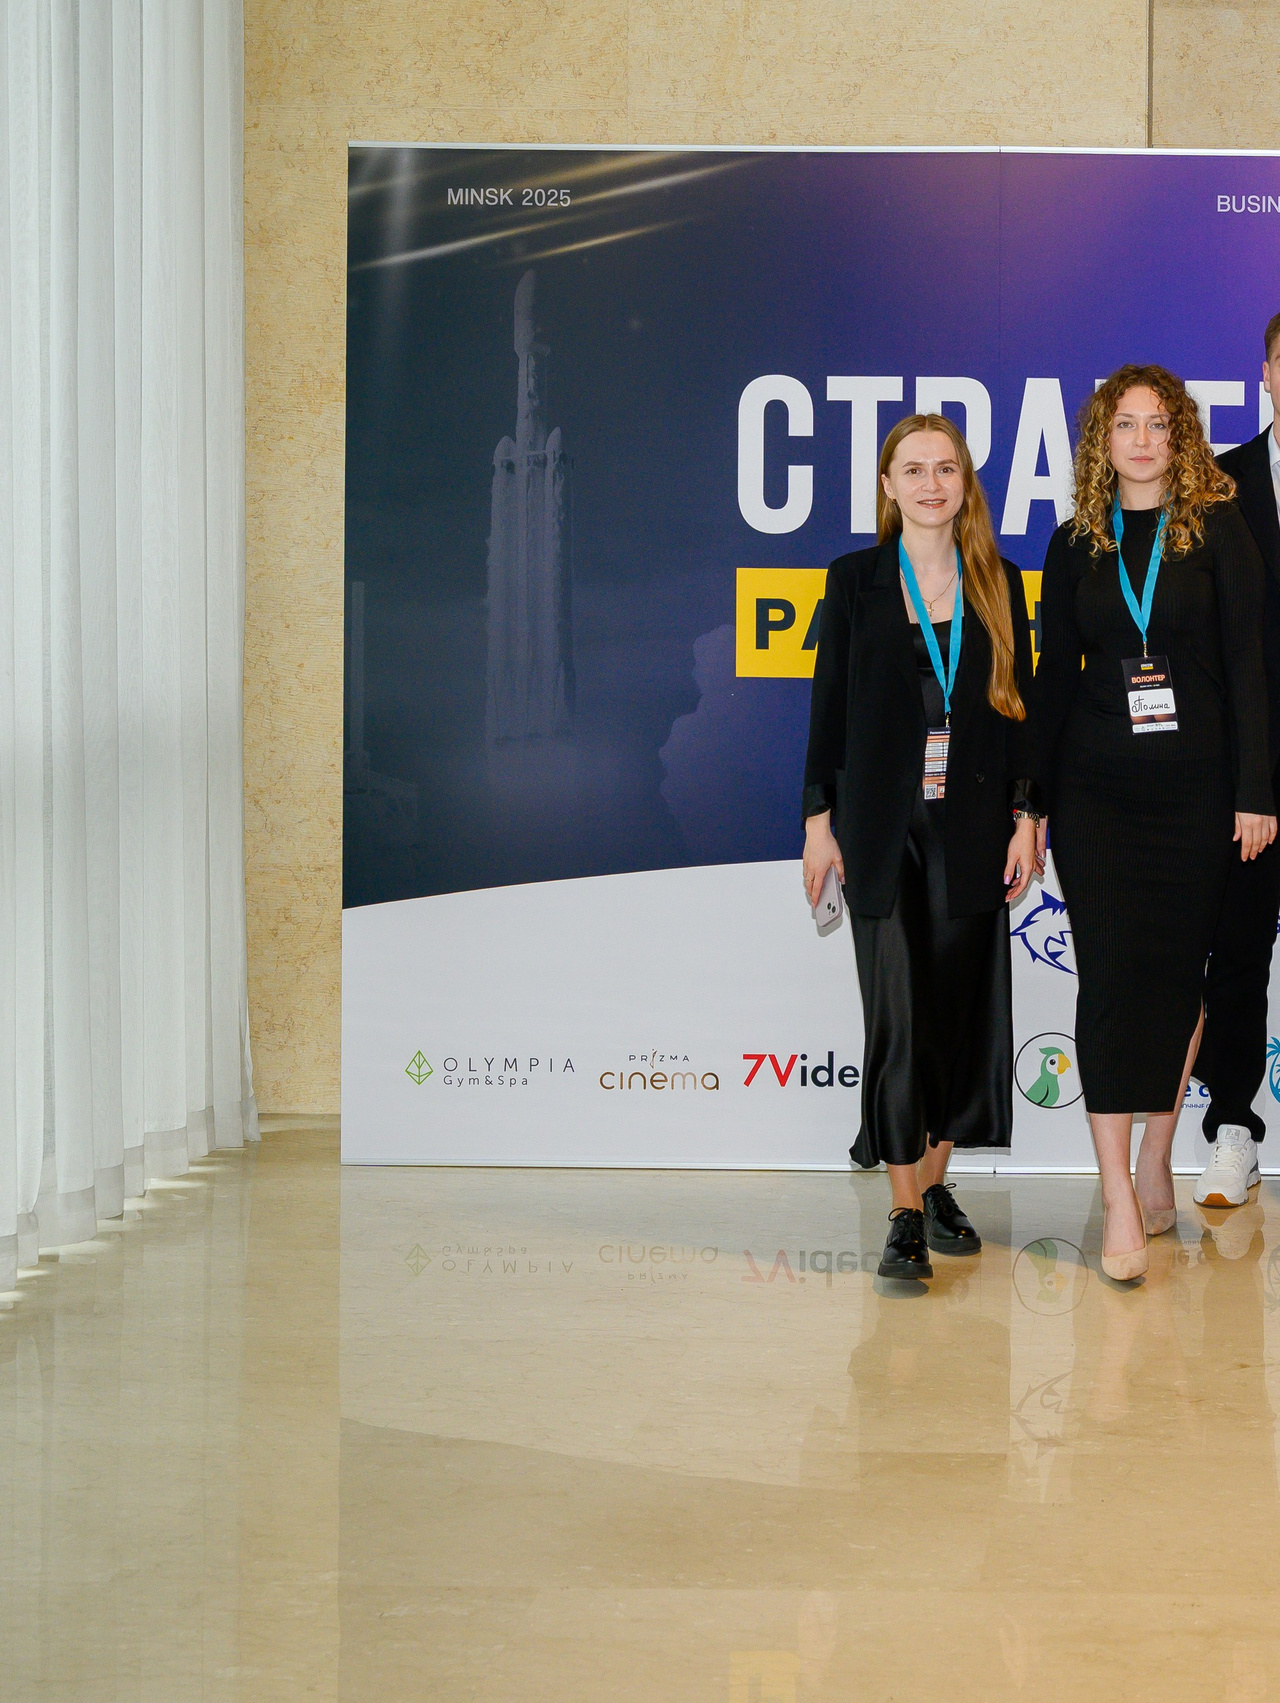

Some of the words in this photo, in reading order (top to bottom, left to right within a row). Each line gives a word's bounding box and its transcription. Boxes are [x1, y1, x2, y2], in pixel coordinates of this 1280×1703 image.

[446, 188, 514, 205] MINSK
[521, 189, 572, 207] 2025
[1131, 674, 1166, 684] ВОЛОНТЕР
[1131, 695, 1171, 713] Полина
[442, 1056, 576, 1074] OLYMPIA
[742, 1050, 860, 1088] 7Vide
[442, 1074, 529, 1088] Gym&Spa
[598, 1071, 721, 1091] cinema
